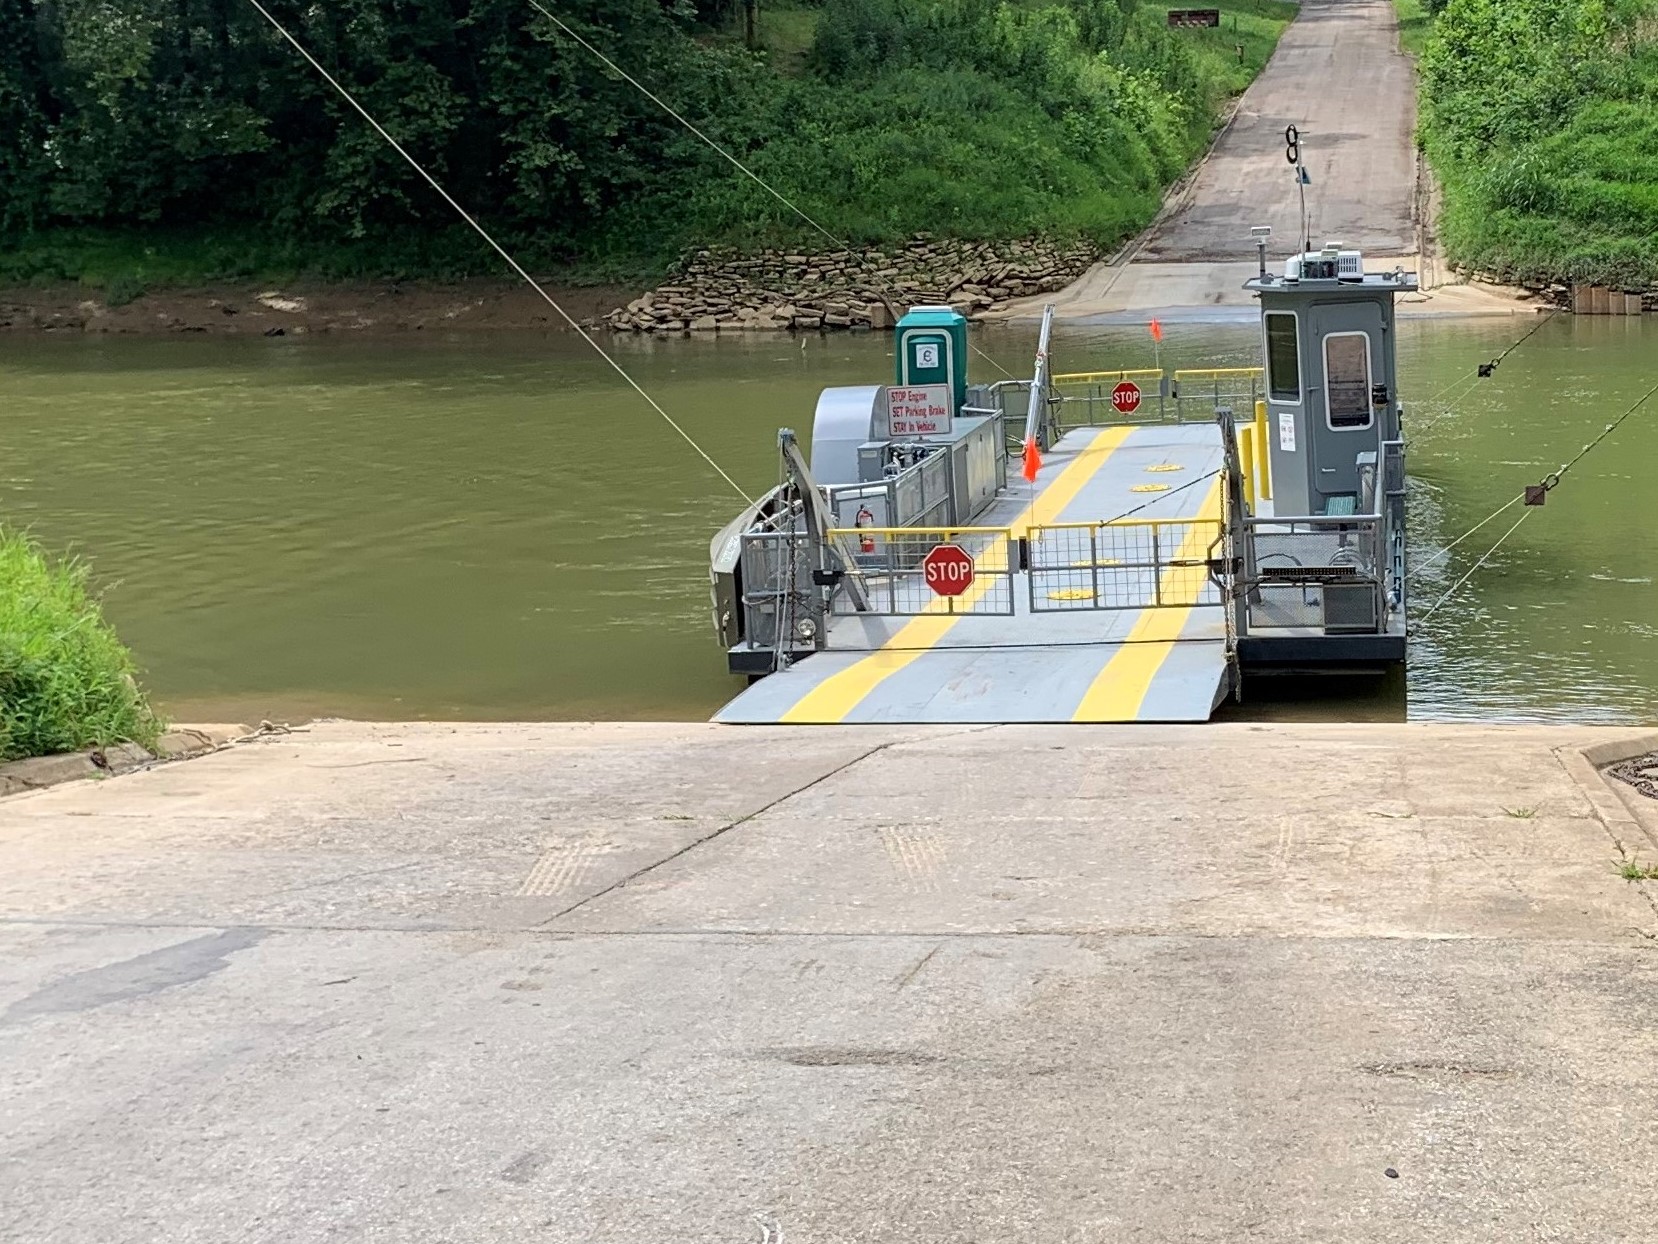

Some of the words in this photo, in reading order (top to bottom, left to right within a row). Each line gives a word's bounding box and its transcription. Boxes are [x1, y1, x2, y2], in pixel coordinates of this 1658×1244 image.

[891, 390, 906, 402] STOP
[908, 390, 927, 403] Engine
[1113, 391, 1139, 404] STOP
[892, 406, 903, 417] SET
[905, 405, 927, 418] Parking
[929, 404, 945, 416] Brake
[893, 421, 906, 432] STAY
[916, 421, 936, 431] Vehicle
[927, 561, 970, 582] STOP
